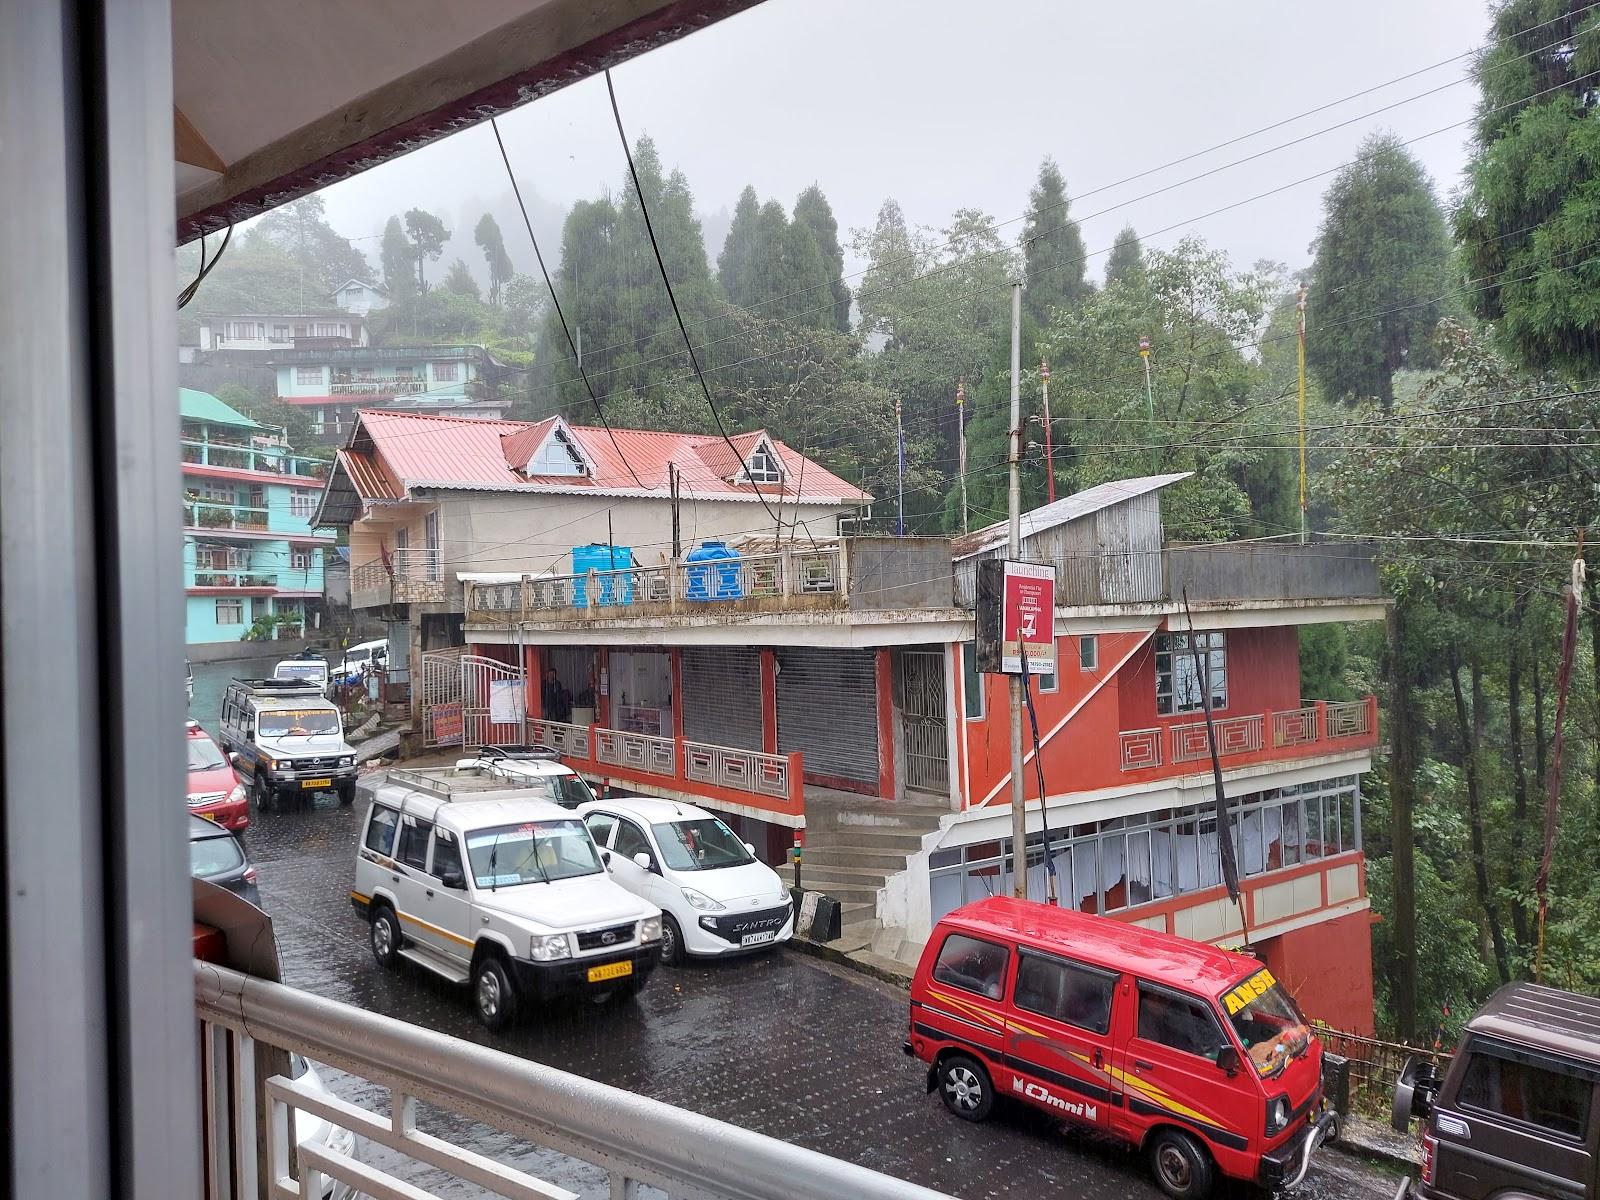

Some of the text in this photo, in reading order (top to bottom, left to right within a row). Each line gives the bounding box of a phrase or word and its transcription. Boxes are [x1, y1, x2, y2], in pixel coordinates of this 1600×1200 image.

[1011, 562, 1049, 580] launching
[1023, 614, 1035, 631] 7
[732, 918, 782, 932] SANTRO
[1224, 968, 1277, 1015] ANSH
[1025, 1083, 1084, 1116] Omni
